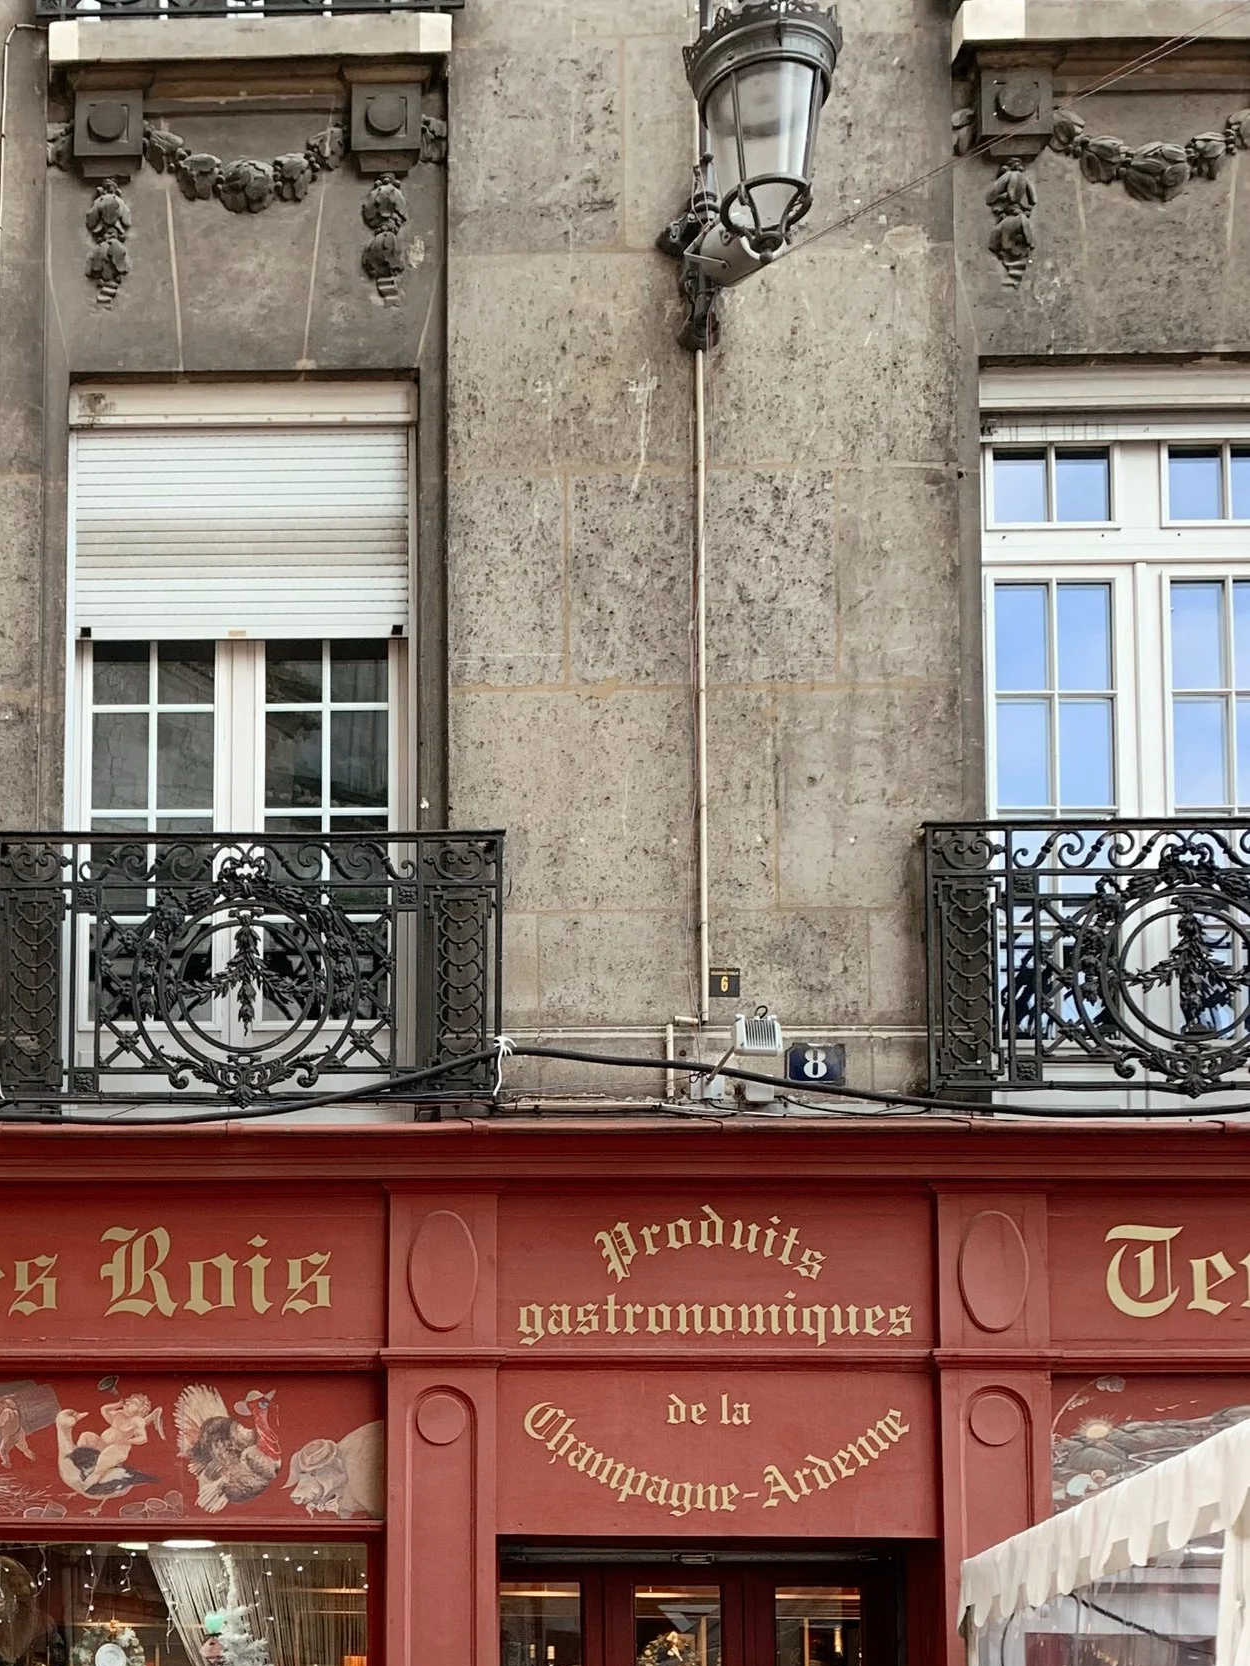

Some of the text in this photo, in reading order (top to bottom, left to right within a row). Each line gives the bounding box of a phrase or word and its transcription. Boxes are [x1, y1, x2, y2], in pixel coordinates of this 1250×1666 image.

[802, 1047, 828, 1080] 8
[99, 1225, 333, 1319] Rois
[593, 1203, 828, 1284] Produits
[1104, 1224, 1250, 1318] Te
[516, 1290, 914, 1347] gastronomiques
[666, 1392, 752, 1426] de la
[522, 1400, 911, 1518] Champagne-Ardenne
